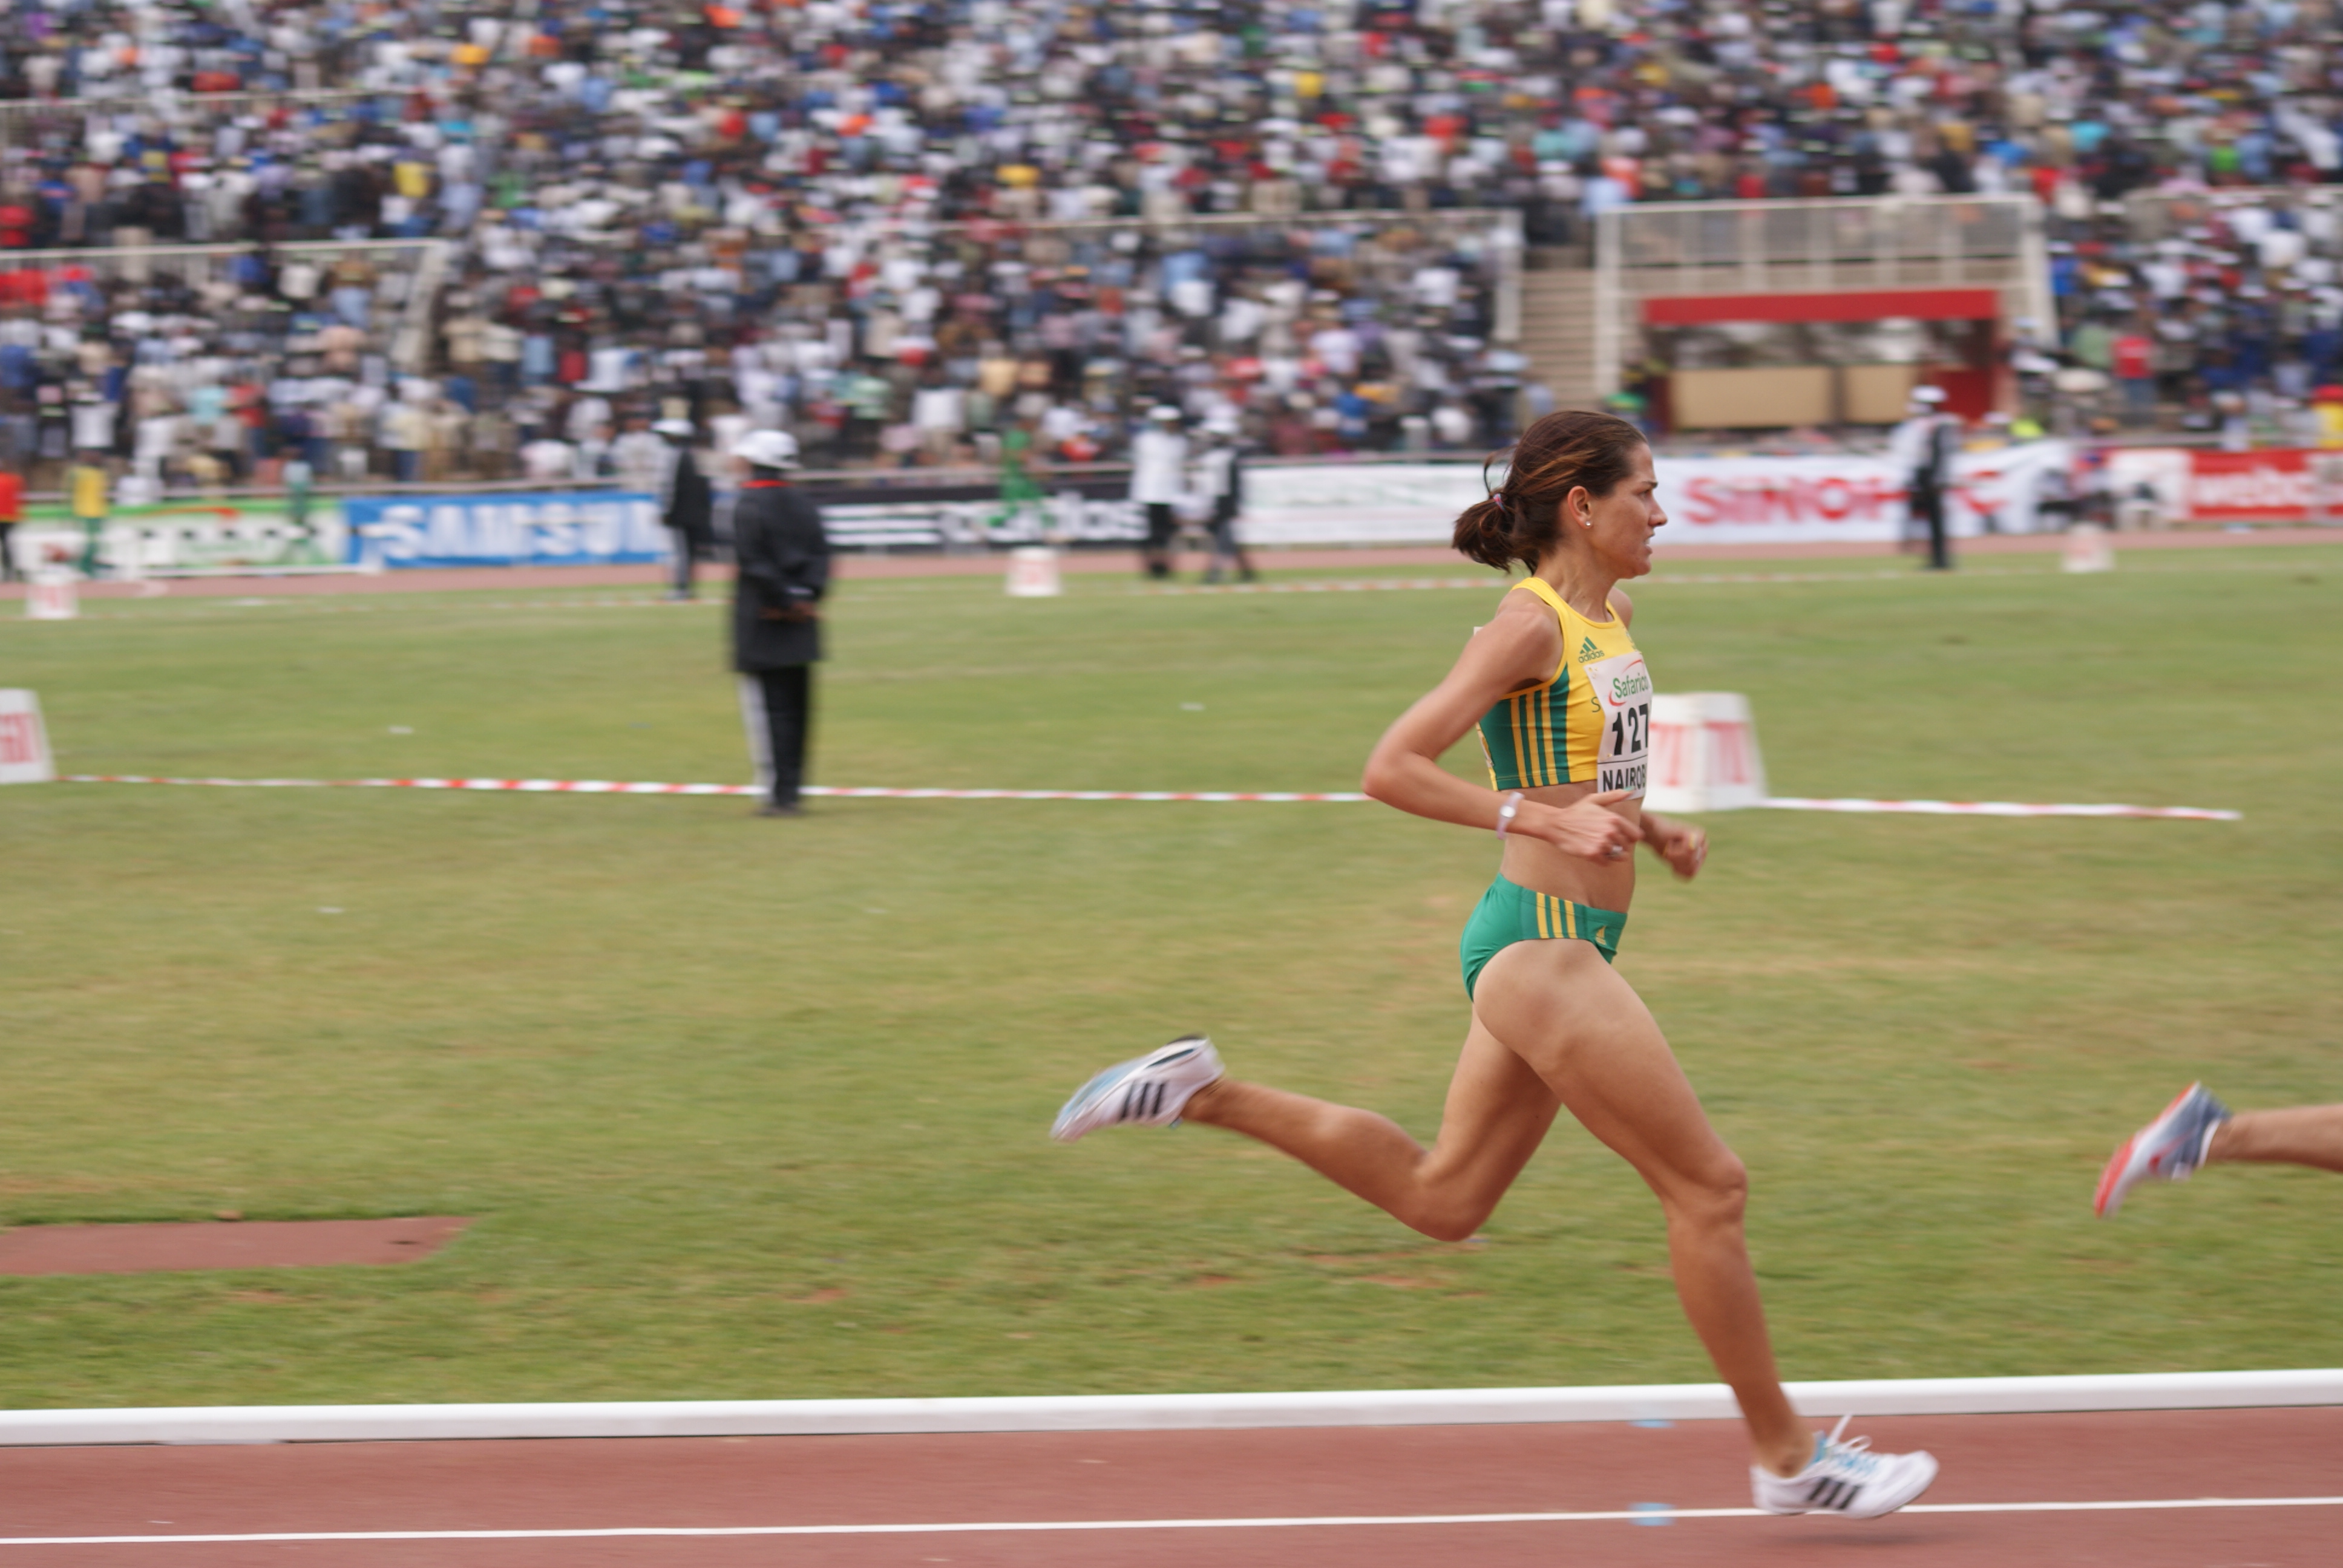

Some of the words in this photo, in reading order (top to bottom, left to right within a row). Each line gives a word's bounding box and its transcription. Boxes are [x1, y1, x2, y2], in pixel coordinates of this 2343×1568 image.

[380, 501, 677, 558] SAMSUN
[1578, 650, 1605, 664] adidas
[1612, 671, 1650, 699] Safarico
[1611, 703, 1648, 756] 127
[1602, 763, 1647, 792] NAIROB
